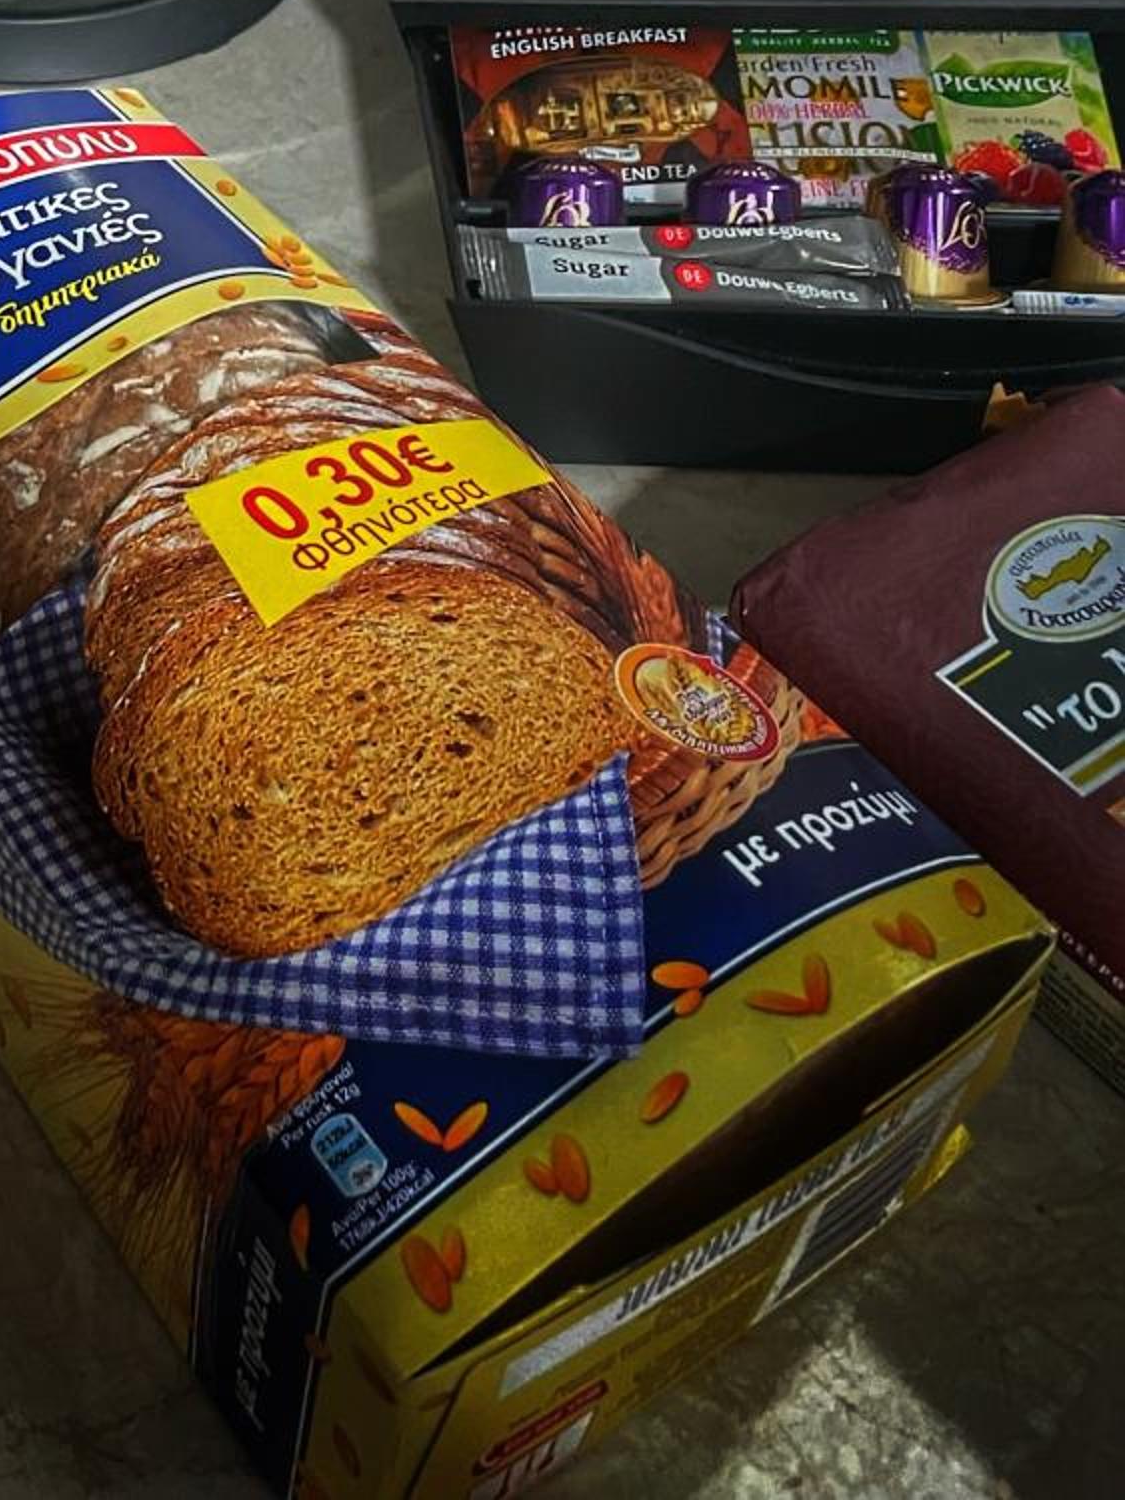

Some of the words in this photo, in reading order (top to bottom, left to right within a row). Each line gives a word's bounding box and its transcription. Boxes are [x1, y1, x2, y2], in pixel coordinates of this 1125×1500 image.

[490, 35, 575, 59] ENGLISH
[580, 28, 688, 49] BREAKFAST
[736, 56, 803, 73] arden
[812, 56, 876, 73] Fresh
[747, 75, 907, 101] MOMILE
[932, 72, 1067, 93] PICKWICK
[621, 166, 660, 182] END
[663, 164, 698, 180] TEA
[696, 227, 764, 240] Douwe
[768, 227, 843, 243] Egberts
[552, 257, 630, 279] Sugar
[785, 281, 860, 303] Egberts
[241, 433, 456, 540] 0,30€
[723, 834, 780, 888] με
[774, 781, 918, 852] προζύμι
[281, 1125, 305, 1149] Per
[334, 1082, 362, 1105] 12g
